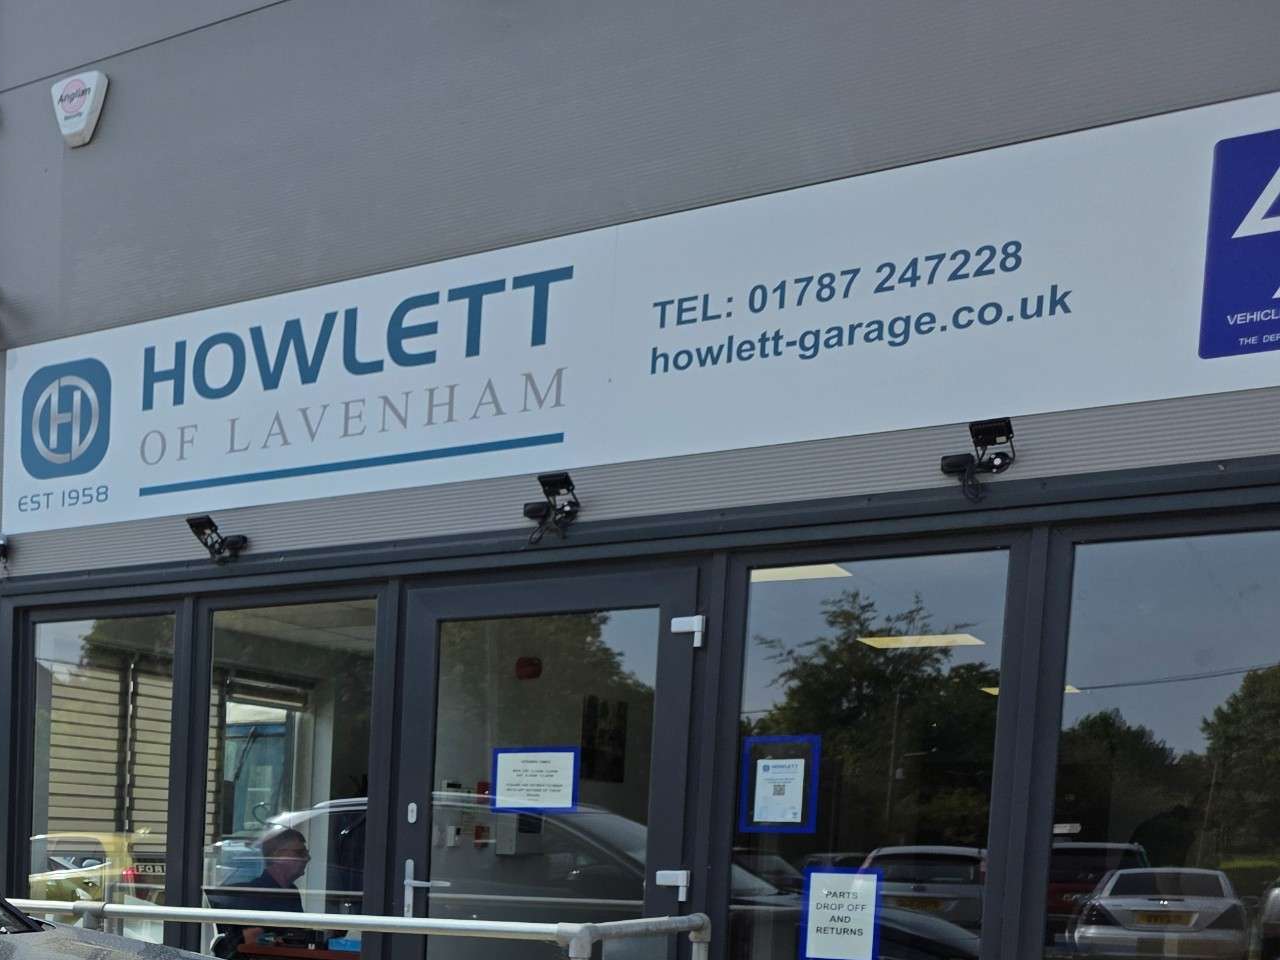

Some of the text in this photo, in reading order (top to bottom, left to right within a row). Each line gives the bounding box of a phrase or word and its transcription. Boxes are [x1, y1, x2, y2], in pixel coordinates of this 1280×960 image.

[652, 239, 1023, 329] TEL: 01787 247228
[141, 264, 574, 411] HOWLETT
[649, 283, 1073, 374] howlett-garage.co.uk
[1239, 336, 1258, 345] THE
[139, 366, 570, 466] OF LAVENHAM
[18, 485, 109, 512] EST 1958
[825, 890, 858, 899] PARTS
[815, 902, 867, 912] DROP OFF
[829, 915, 852, 923] AND
[815, 926, 864, 936] RETURNS
